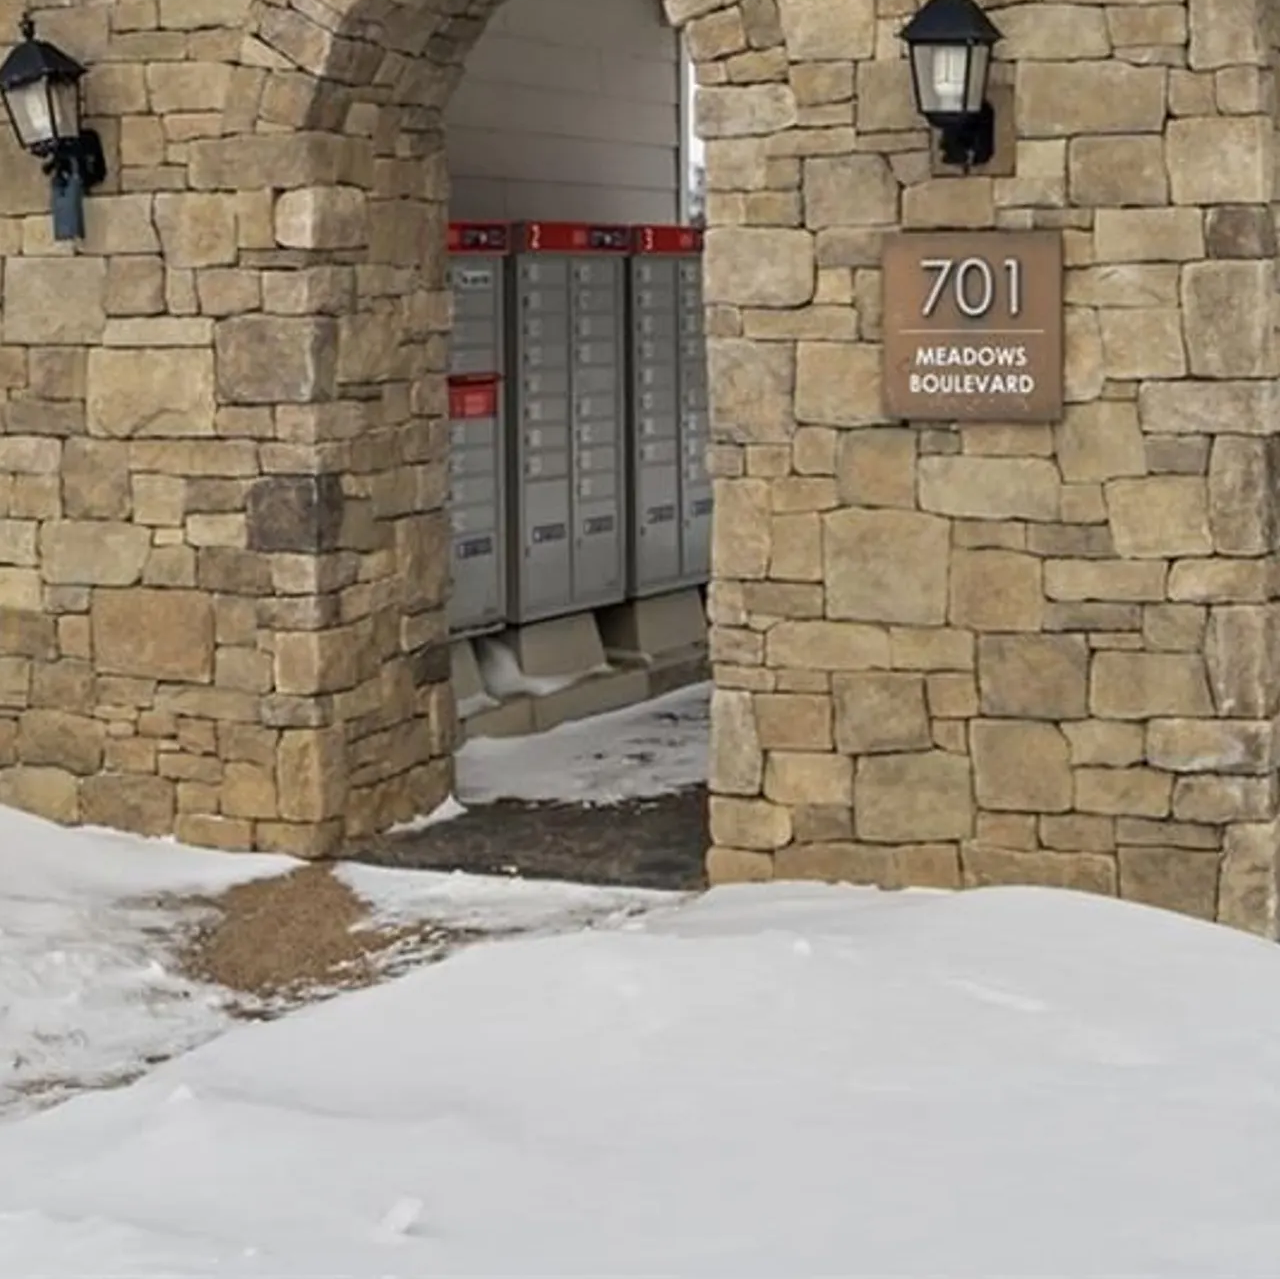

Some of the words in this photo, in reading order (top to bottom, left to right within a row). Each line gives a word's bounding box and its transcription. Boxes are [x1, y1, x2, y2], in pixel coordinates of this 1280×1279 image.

[920, 257, 1019, 316] 701
[916, 346, 1027, 366] MEADOWS
[910, 374, 1035, 393] BOULEVARD
